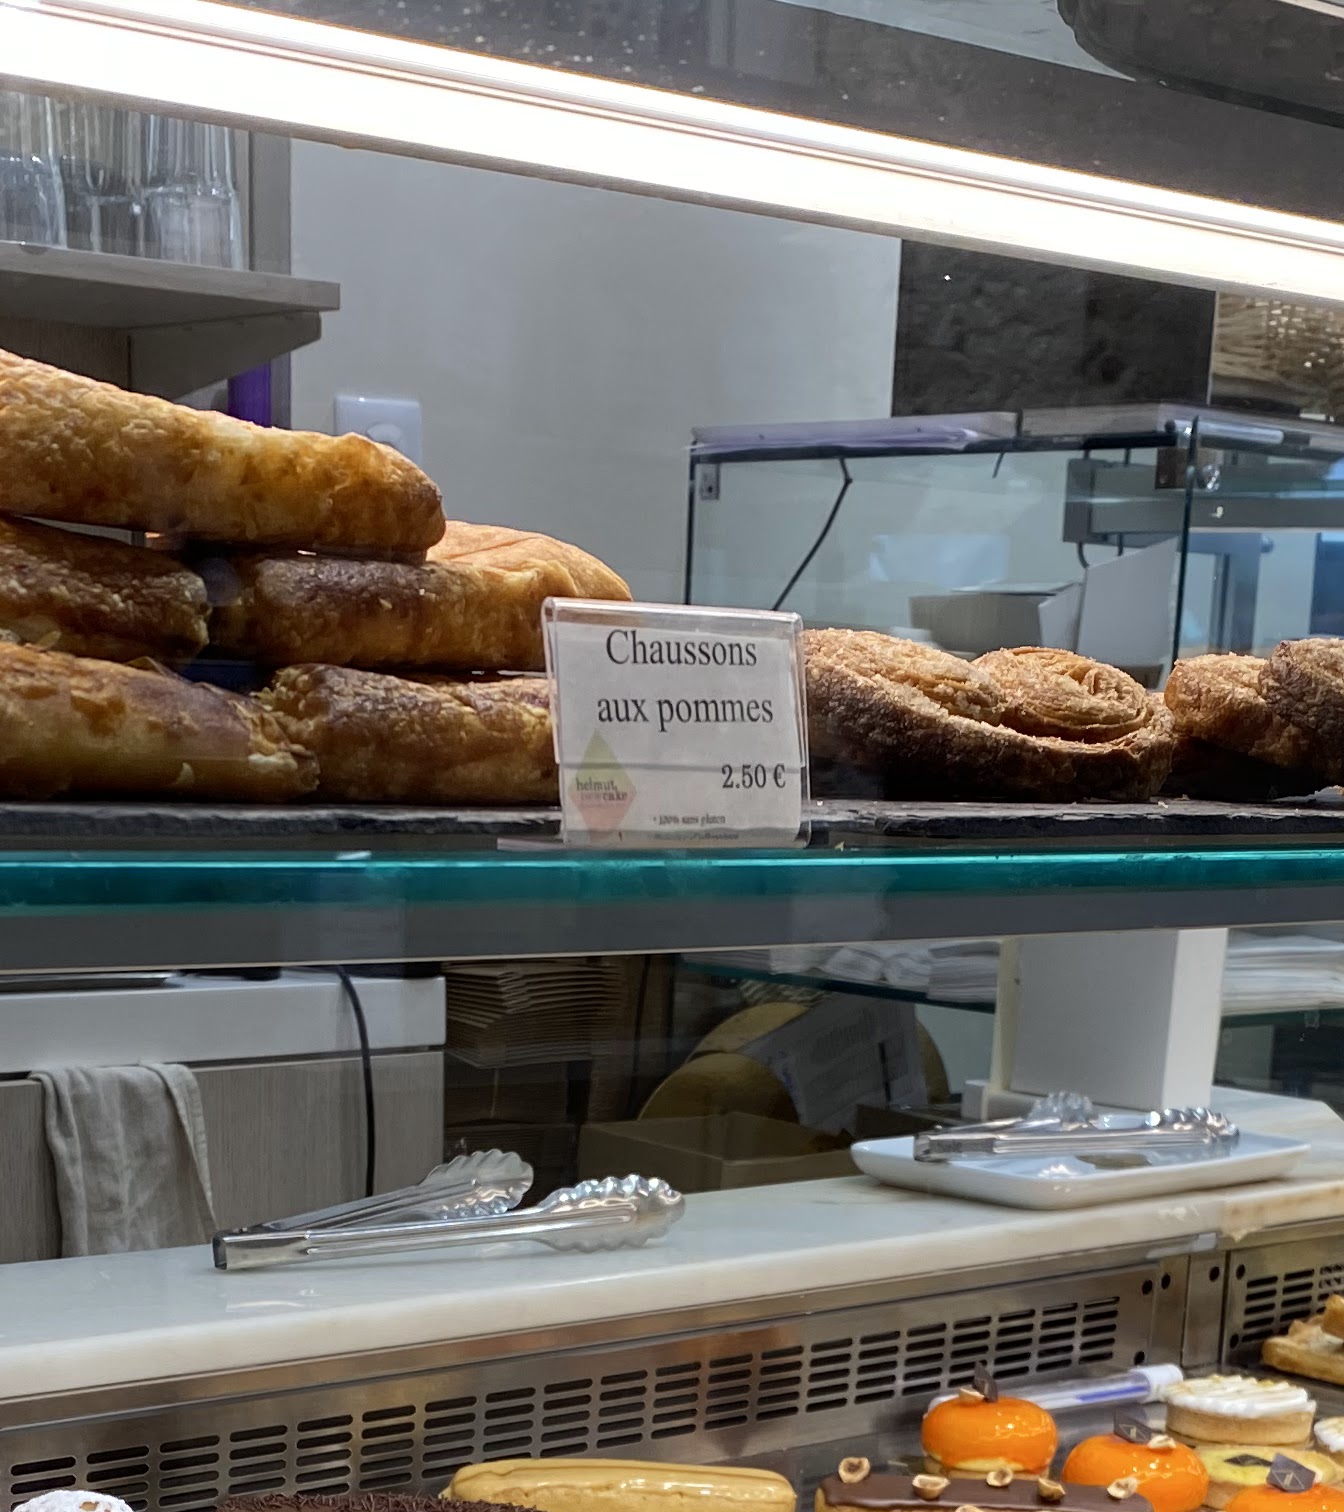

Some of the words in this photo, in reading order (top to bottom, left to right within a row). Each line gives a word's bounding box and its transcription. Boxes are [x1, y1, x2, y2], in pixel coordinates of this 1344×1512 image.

[606, 629, 757, 666] Chaussons
[598, 698, 649, 723] aux
[658, 697, 774, 732] pommes
[721, 764, 767, 789] 2.50
[773, 763, 787, 789] €
